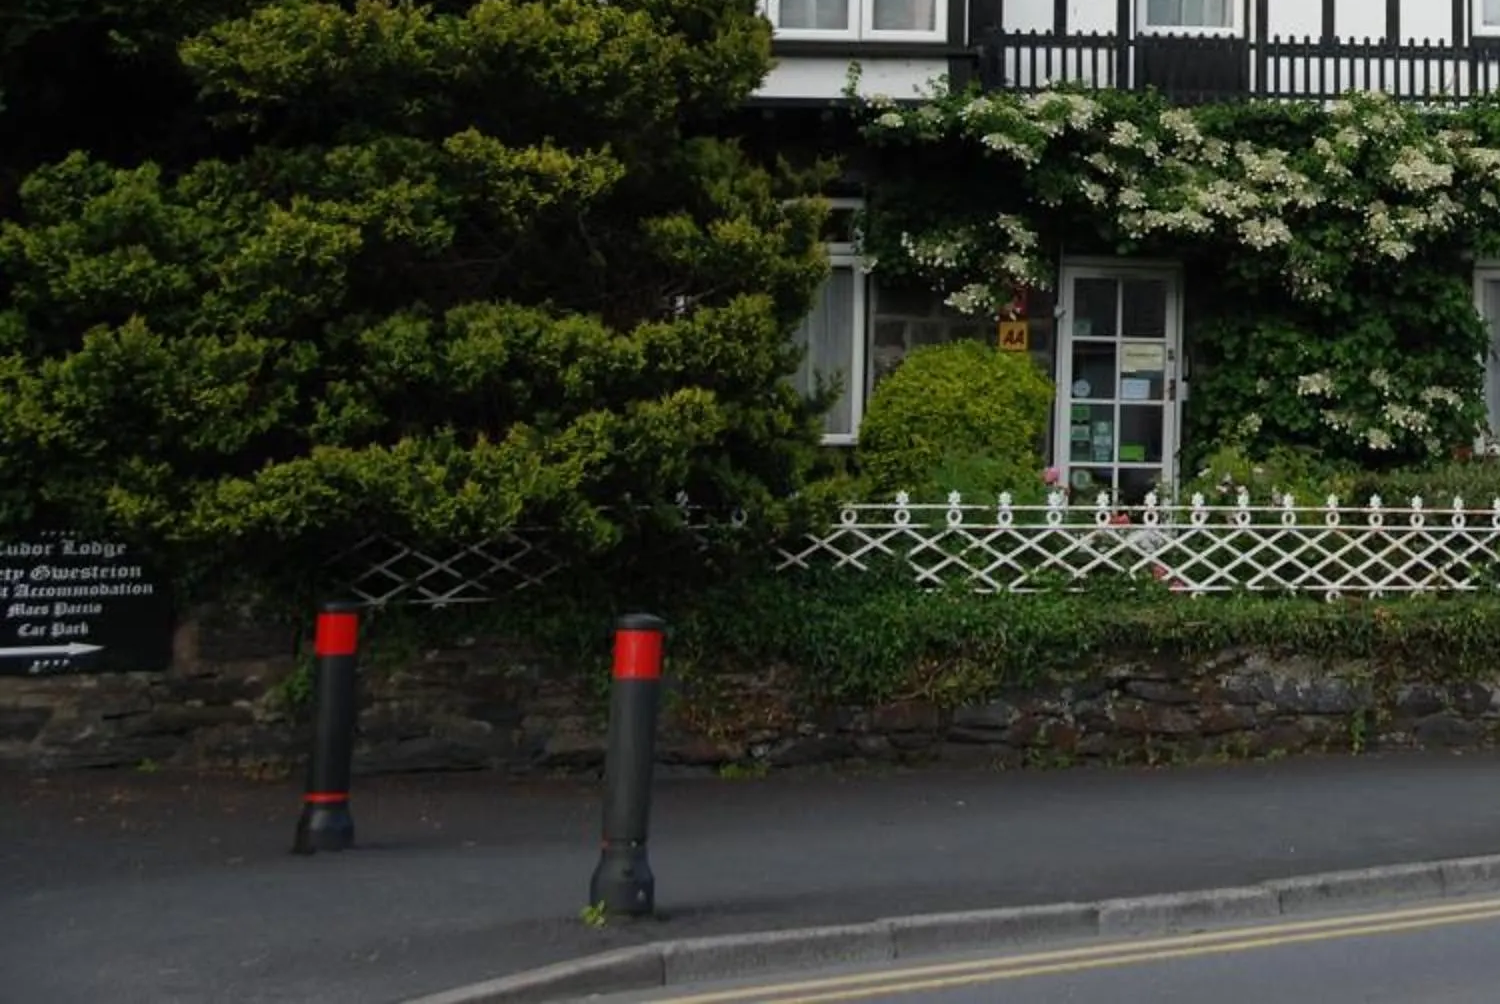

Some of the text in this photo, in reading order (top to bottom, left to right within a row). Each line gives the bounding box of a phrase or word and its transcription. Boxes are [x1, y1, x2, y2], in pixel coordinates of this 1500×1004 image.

[1003, 329, 1024, 345] AA
[61, 539, 127, 558] Lodge
[13, 582, 153, 598] Accommodation
[17, 621, 89, 638] Car Park
